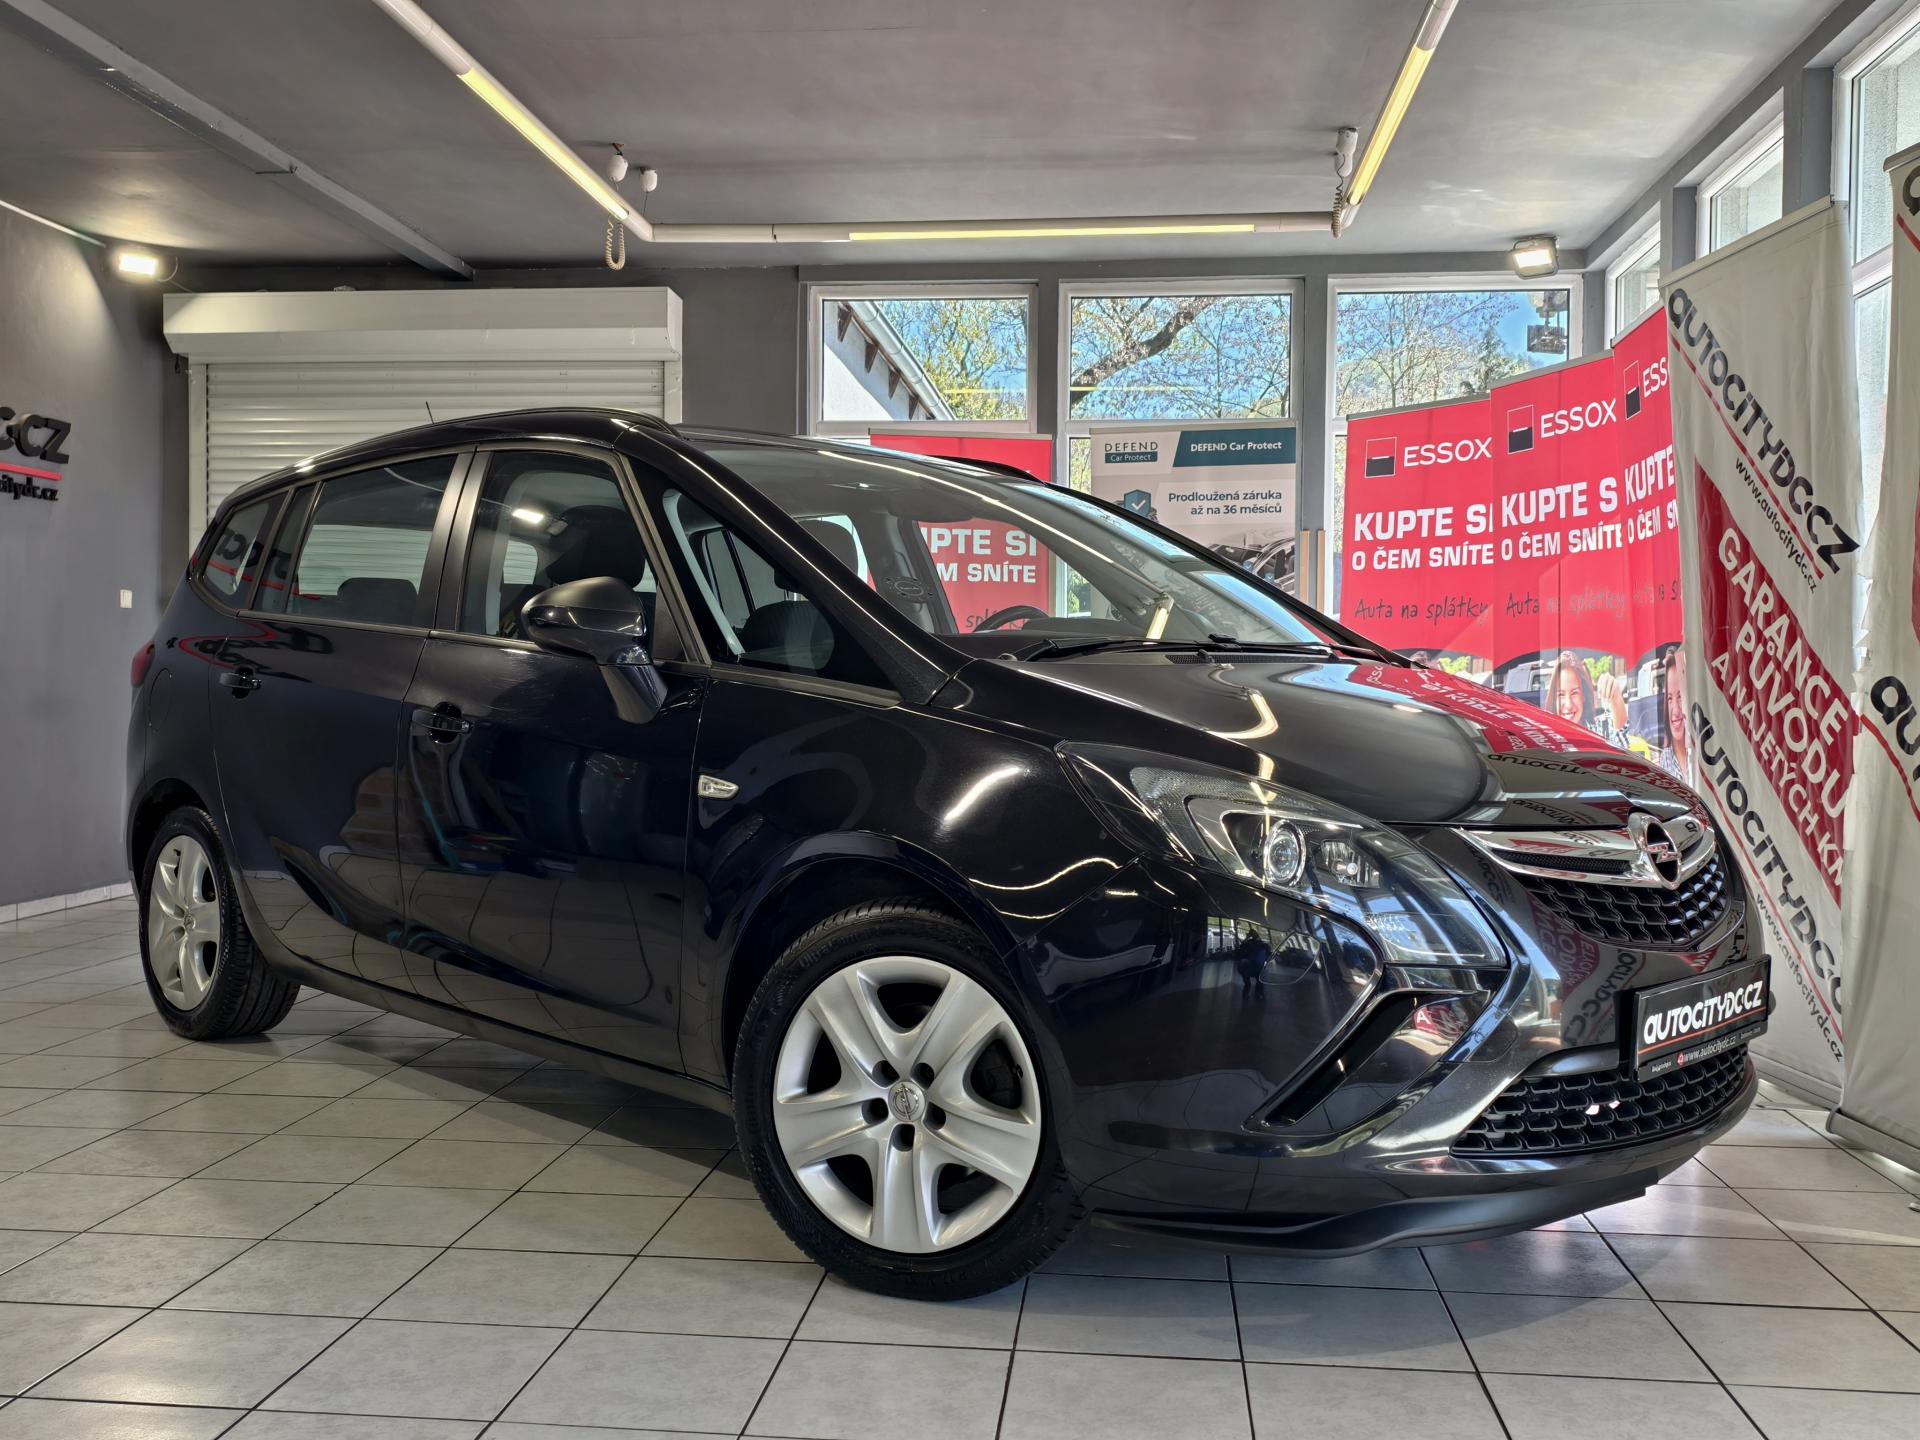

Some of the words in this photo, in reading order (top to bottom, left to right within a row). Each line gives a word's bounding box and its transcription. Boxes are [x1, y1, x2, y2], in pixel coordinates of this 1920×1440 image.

[1643, 357, 1669, 398] ESS
[1540, 398, 1617, 438] ESSOX
[1104, 441, 1158, 452] DEFEND
[1110, 454, 1123, 462] Car
[1124, 453, 1151, 461] Protect
[1190, 443, 1227, 452] DEFEND
[1229, 442, 1245, 451] Car
[1247, 441, 1282, 450] Protect
[1403, 437, 1492, 467] ESSOX
[1624, 444, 1675, 505] KUPTE
[1168, 490, 1240, 503] Prodloužená
[1242, 490, 1282, 500] záruka
[1190, 504, 1204, 516] až
[1206, 507, 1221, 515] na
[1223, 505, 1237, 514] 36
[1239, 502, 1282, 515] měsíců
[1501, 481, 1588, 528] KUPTE
[1599, 476, 1618, 513] S
[1354, 506, 1453, 542] KUPTE
[1627, 517, 1634, 544] O
[1637, 505, 1661, 541] ČEM
[1666, 498, 1679, 530] SN
[1735, 458, 1817, 594] www.autocitydc.cz
[921, 527, 991, 555] PTE
[1005, 530, 1037, 556] SI
[1352, 550, 1366, 571] O
[1372, 542, 1421, 570] ČEM
[1428, 539, 1494, 568] SNÍTE
[1501, 538, 1513, 561] O
[1518, 531, 1561, 559] ČEM
[1568, 520, 1622, 553] SNÍTE
[967, 561, 1036, 583] SNÍTE
[1355, 598, 1393, 618] Auta
[1401, 603, 1418, 617] na
[1426, 596, 1488, 626] splátky
[1506, 591, 1539, 617] Auta
[1718, 527, 1848, 746] GARANCE
[1736, 620, 1849, 818] PŮVODU
[1710, 652, 1729, 682] A
[1729, 674, 1819, 836] NAJETÝCH
[1756, 894, 1843, 1062] www.autocitydc.cz
[1684, 1036, 1736, 1062] www.autocitydc.cz
